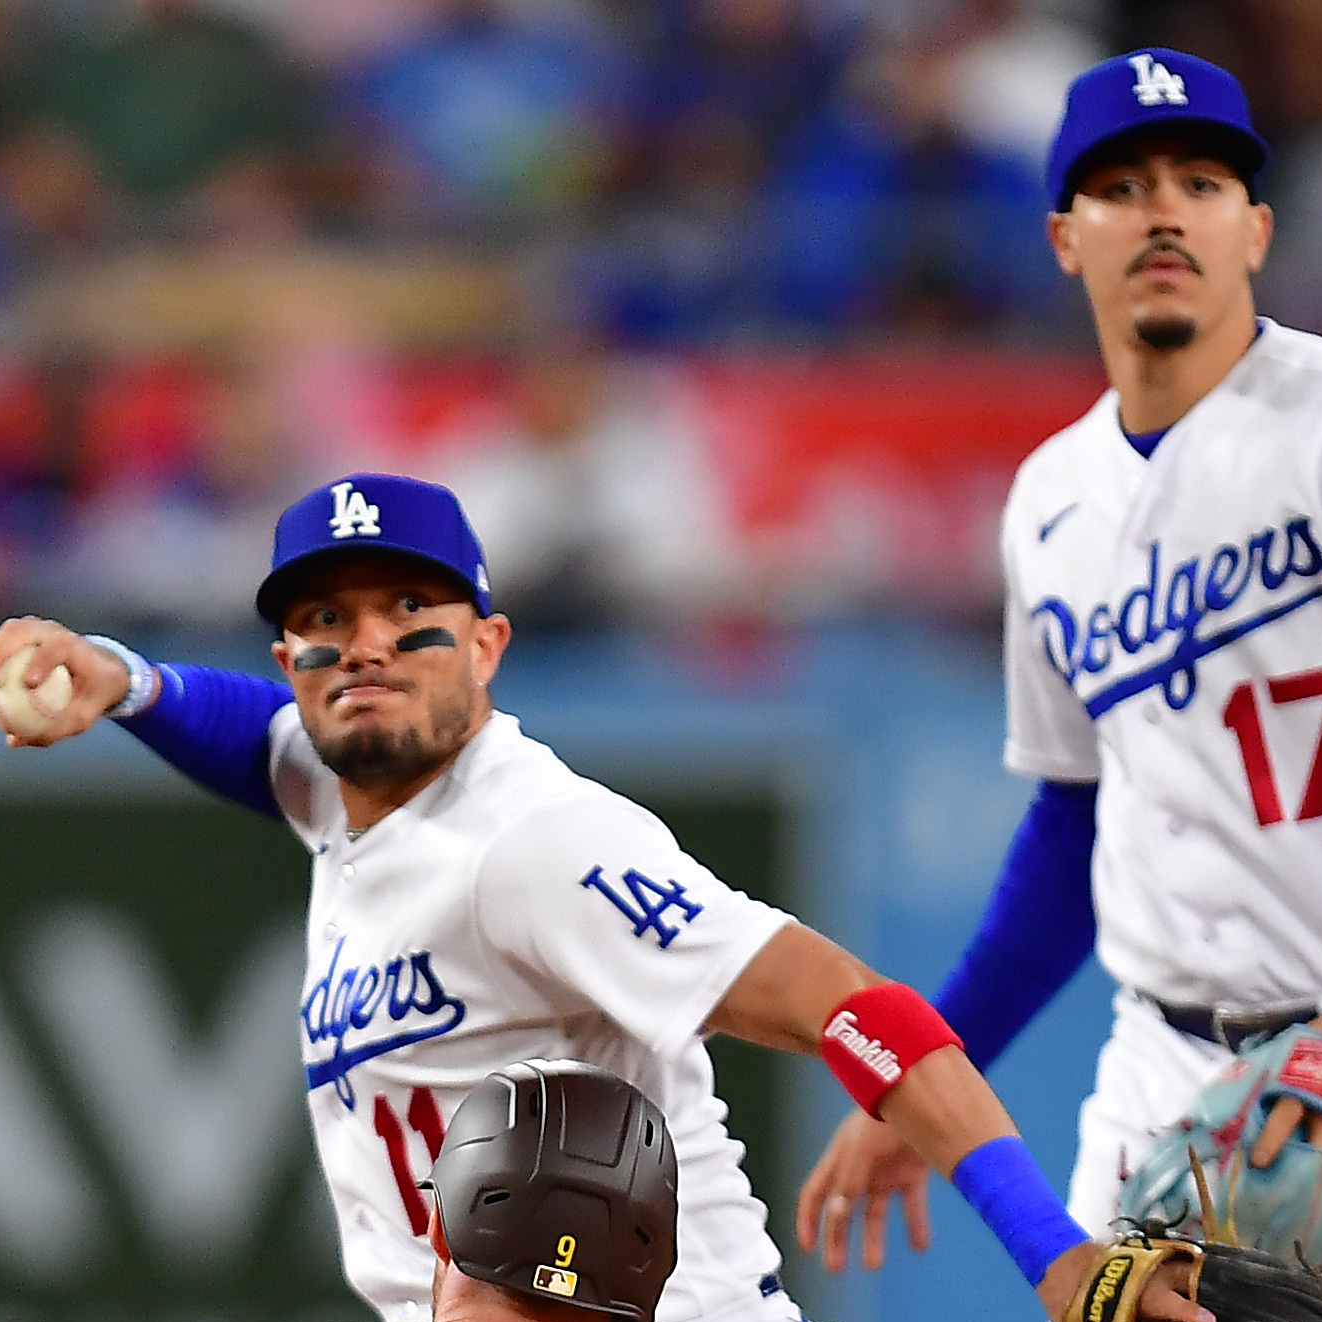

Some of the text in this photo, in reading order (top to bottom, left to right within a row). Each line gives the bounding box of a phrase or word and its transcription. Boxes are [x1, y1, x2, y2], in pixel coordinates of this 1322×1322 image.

[1128, 52, 1188, 106] LA
[329, 481, 382, 538] LA
[579, 863, 705, 950] LA
[300, 935, 467, 1111] dgers
[554, 1235, 576, 1268] 9
